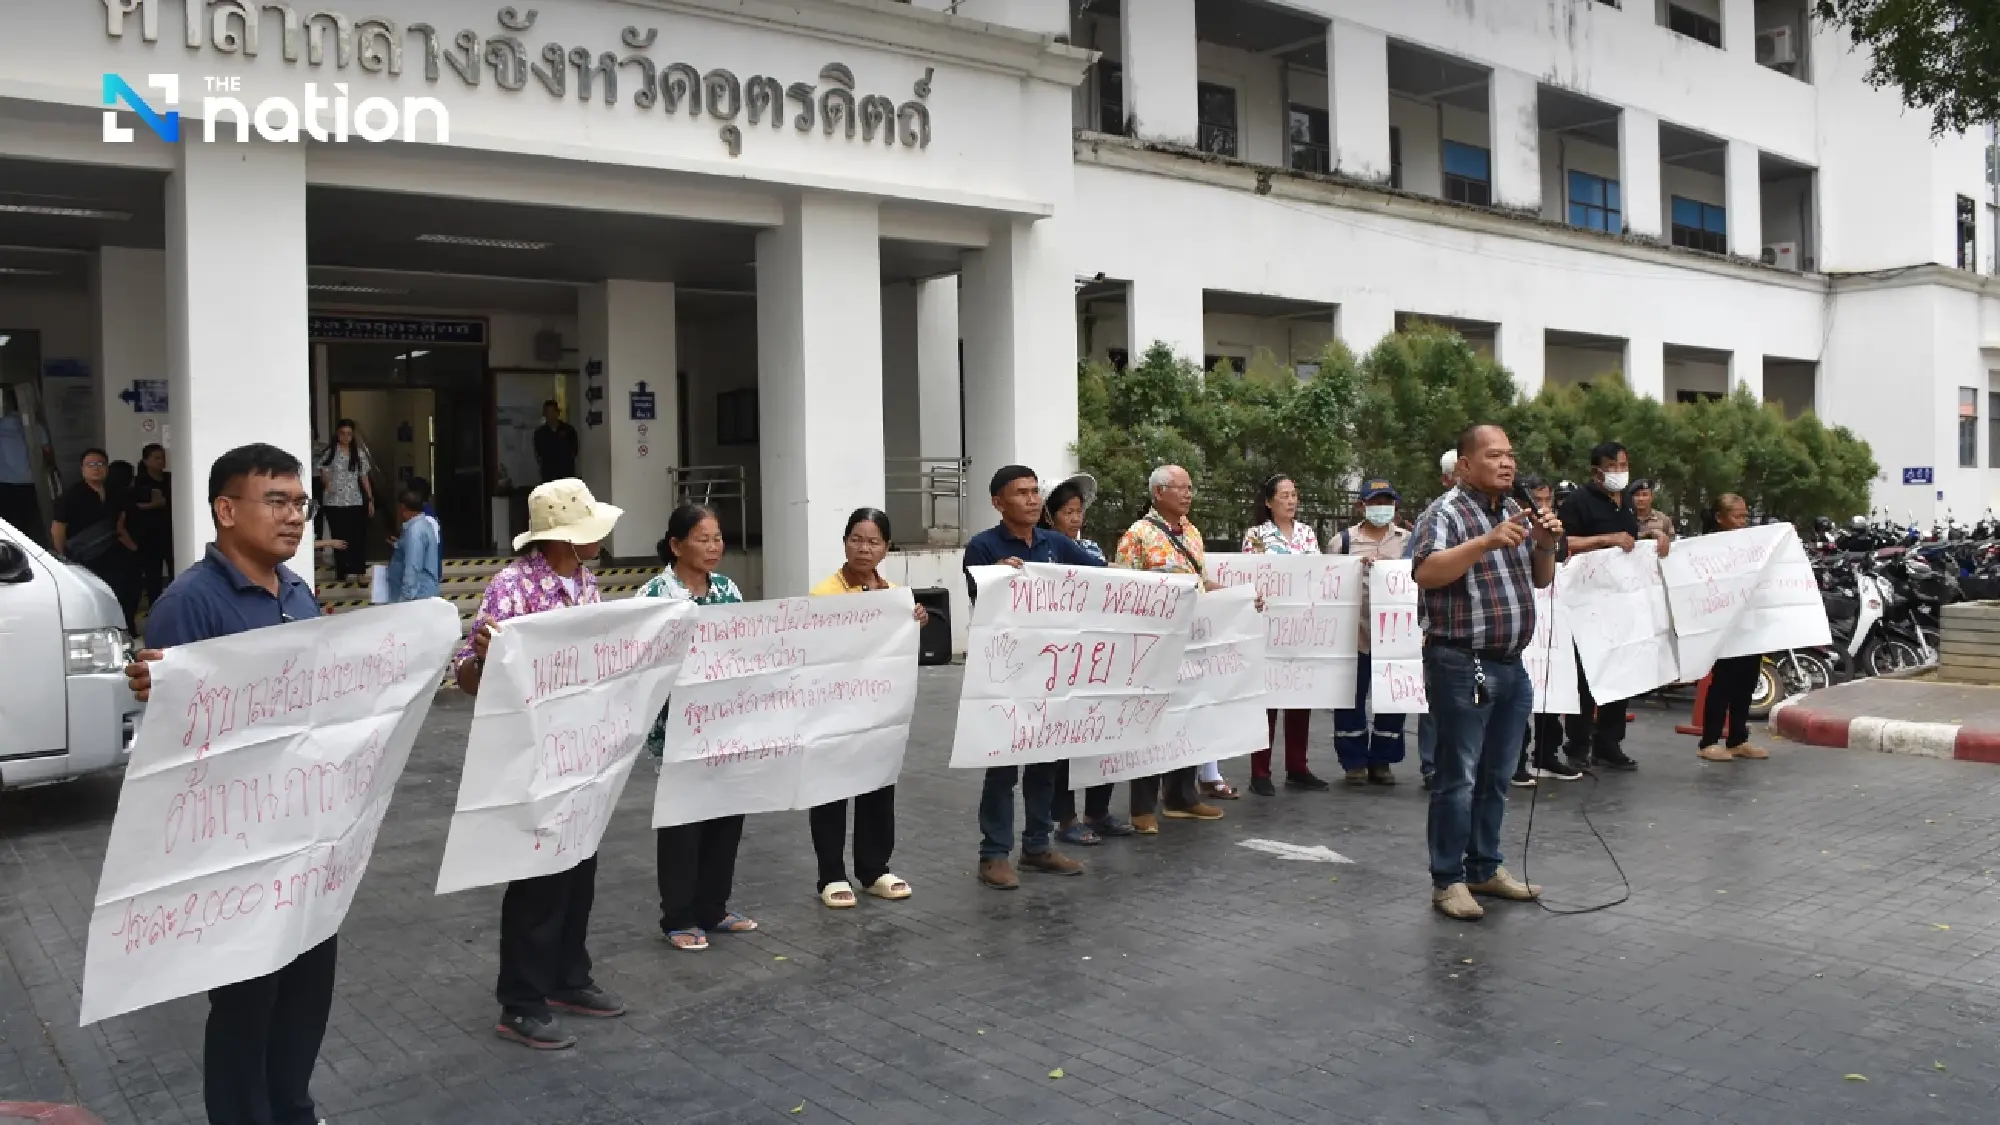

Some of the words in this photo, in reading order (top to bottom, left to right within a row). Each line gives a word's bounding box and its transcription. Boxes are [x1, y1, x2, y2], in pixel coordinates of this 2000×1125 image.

[1009, 568, 1090, 614] พอแล้ว
[1101, 575, 1181, 620] พอแล้ว
